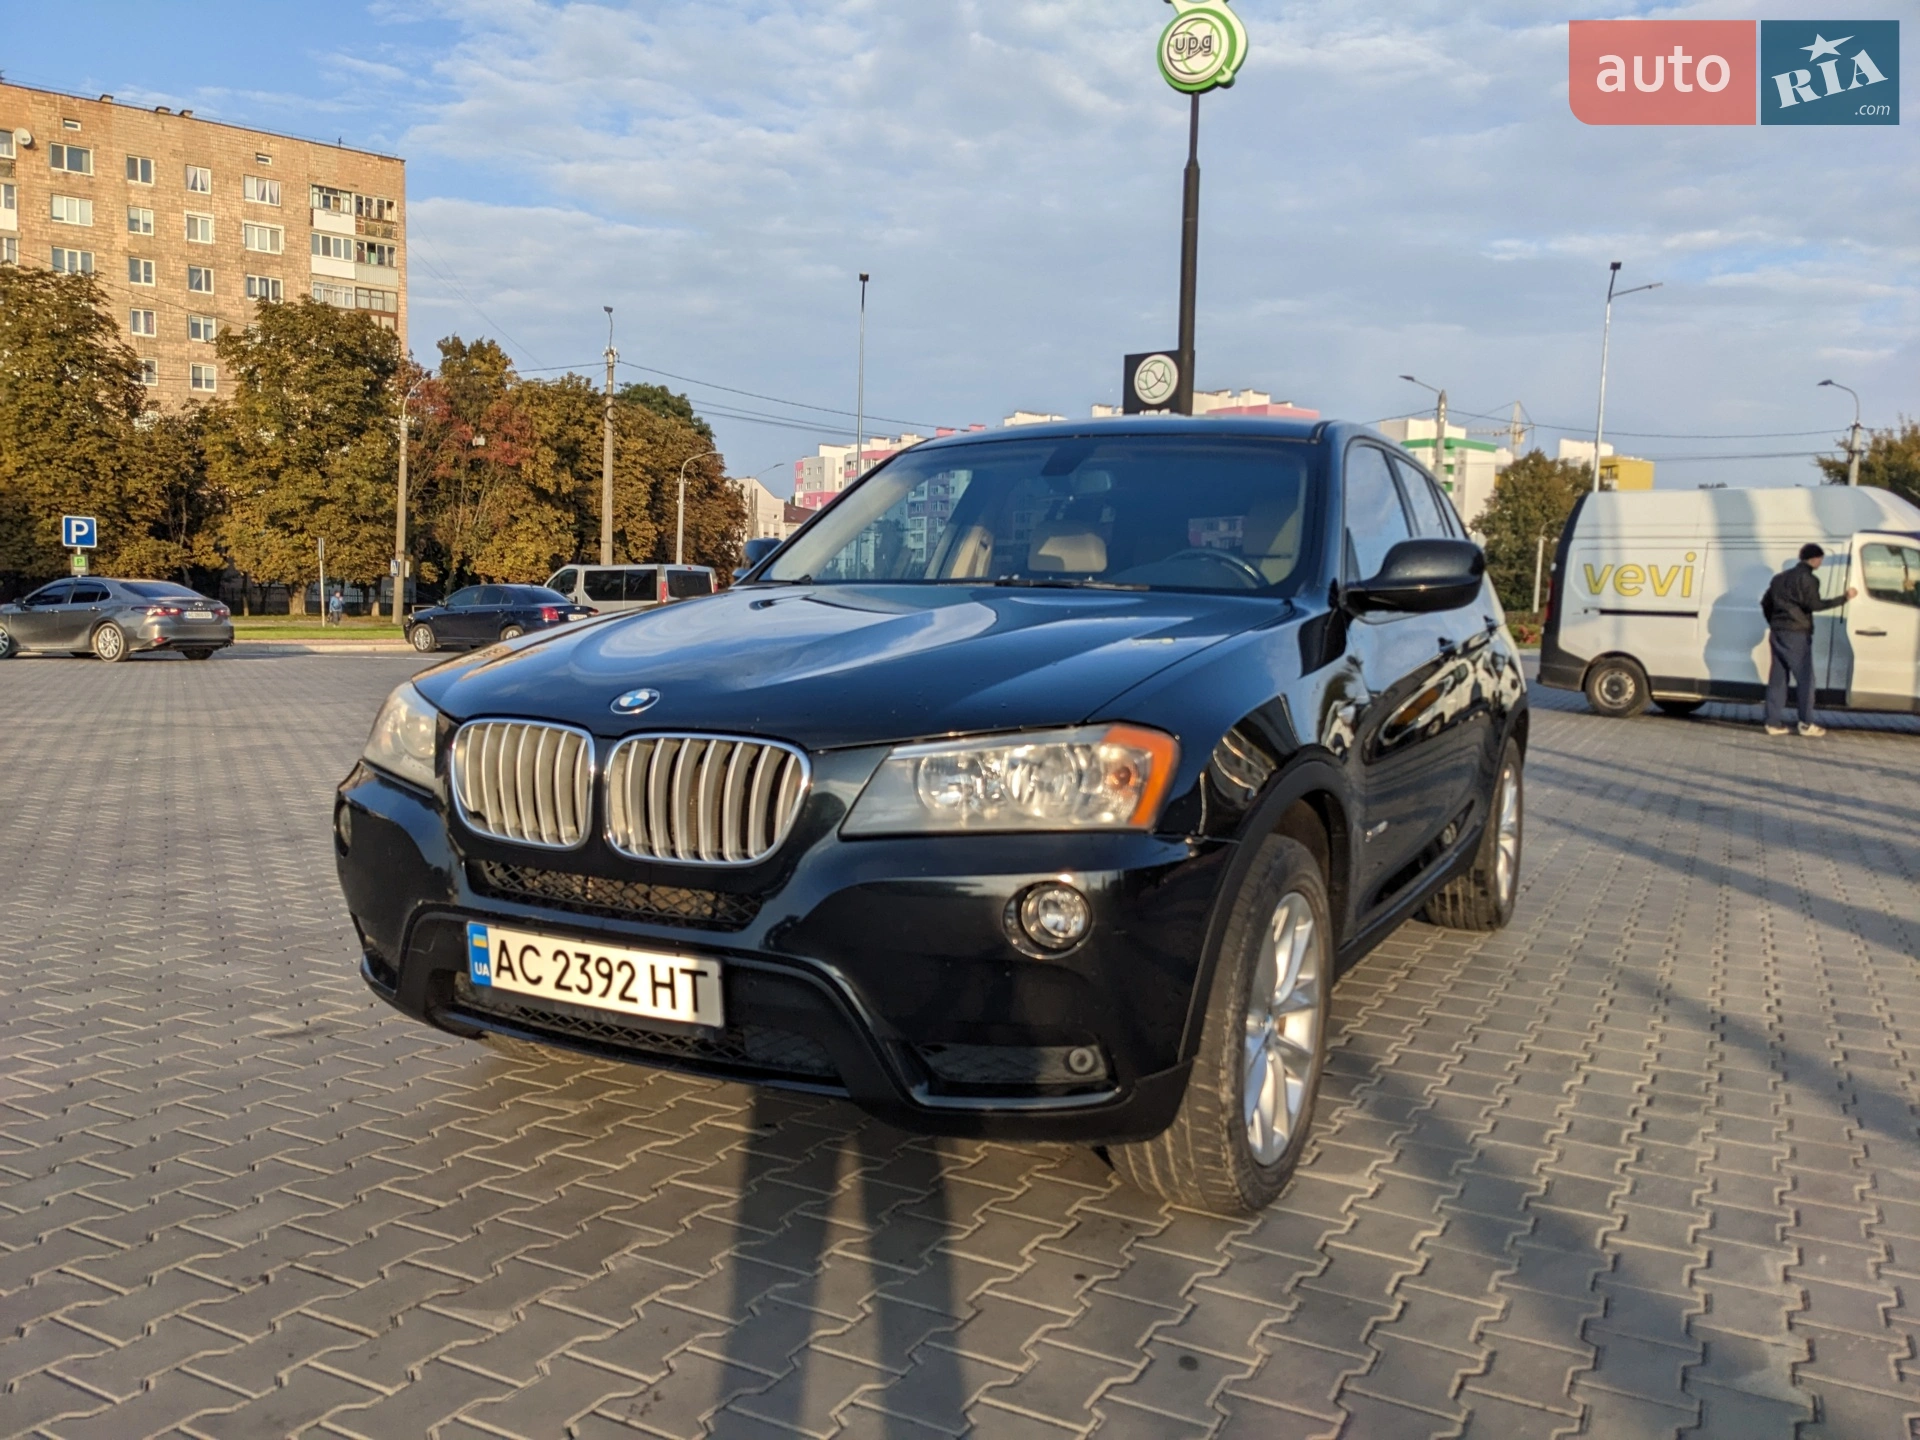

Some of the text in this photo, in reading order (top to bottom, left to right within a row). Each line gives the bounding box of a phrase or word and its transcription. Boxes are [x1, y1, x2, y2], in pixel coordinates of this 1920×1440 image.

[1174, 34, 1213, 58] upg
[71, 520, 89, 543] P
[1583, 551, 1698, 598] vevi
[474, 961, 490, 977] UA
[495, 939, 709, 1013] AC 2392 HT
